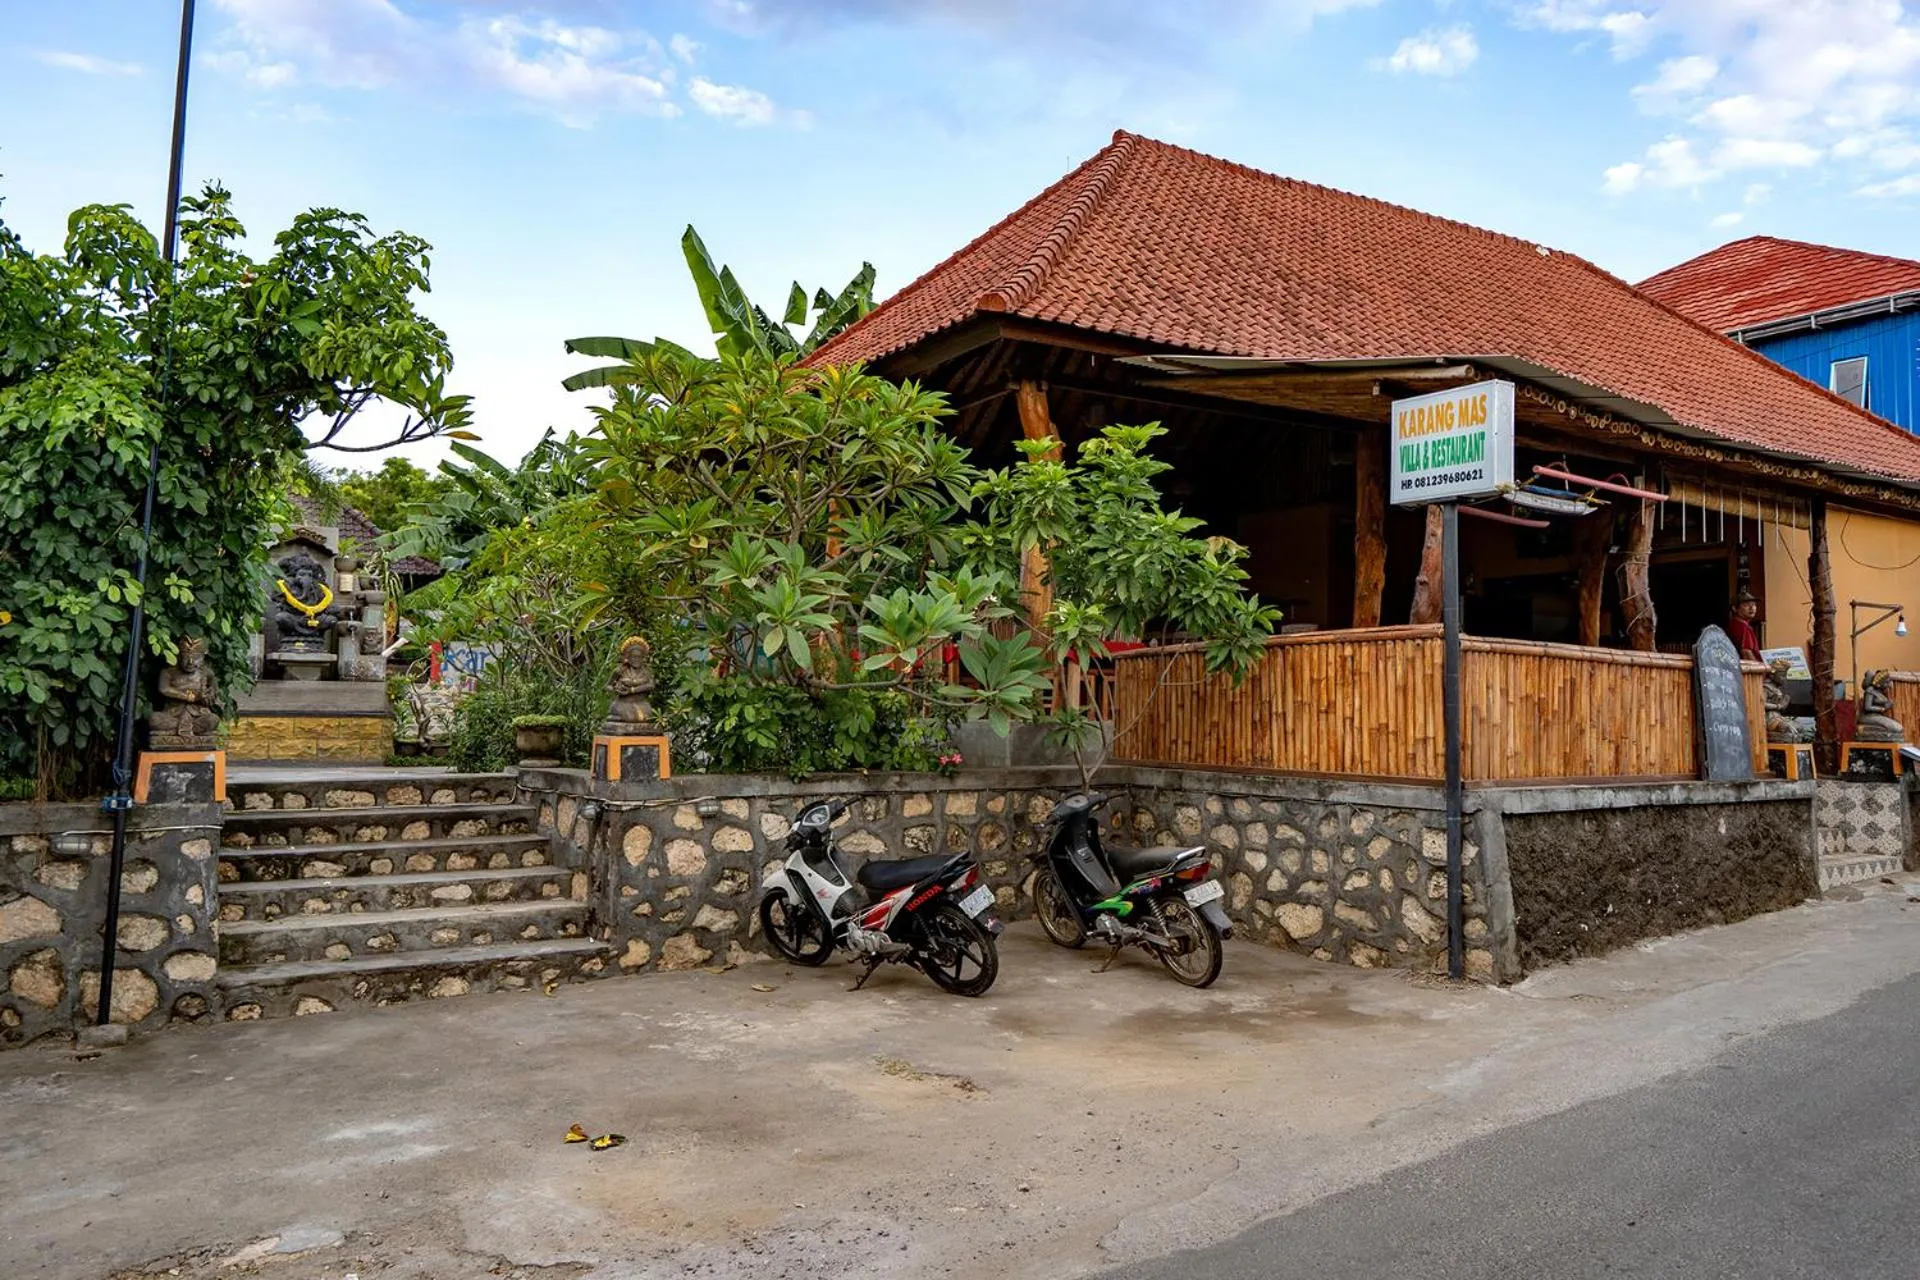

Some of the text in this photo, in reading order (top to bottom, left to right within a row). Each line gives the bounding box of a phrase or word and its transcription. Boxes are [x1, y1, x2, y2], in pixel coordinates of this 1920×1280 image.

[1399, 393, 1488, 439] KARANG MAS
[1399, 431, 1486, 473] VILLA & RESTAURANT
[1415, 469, 1483, 488] 081239680621
[904, 885, 944, 911] HONDA
